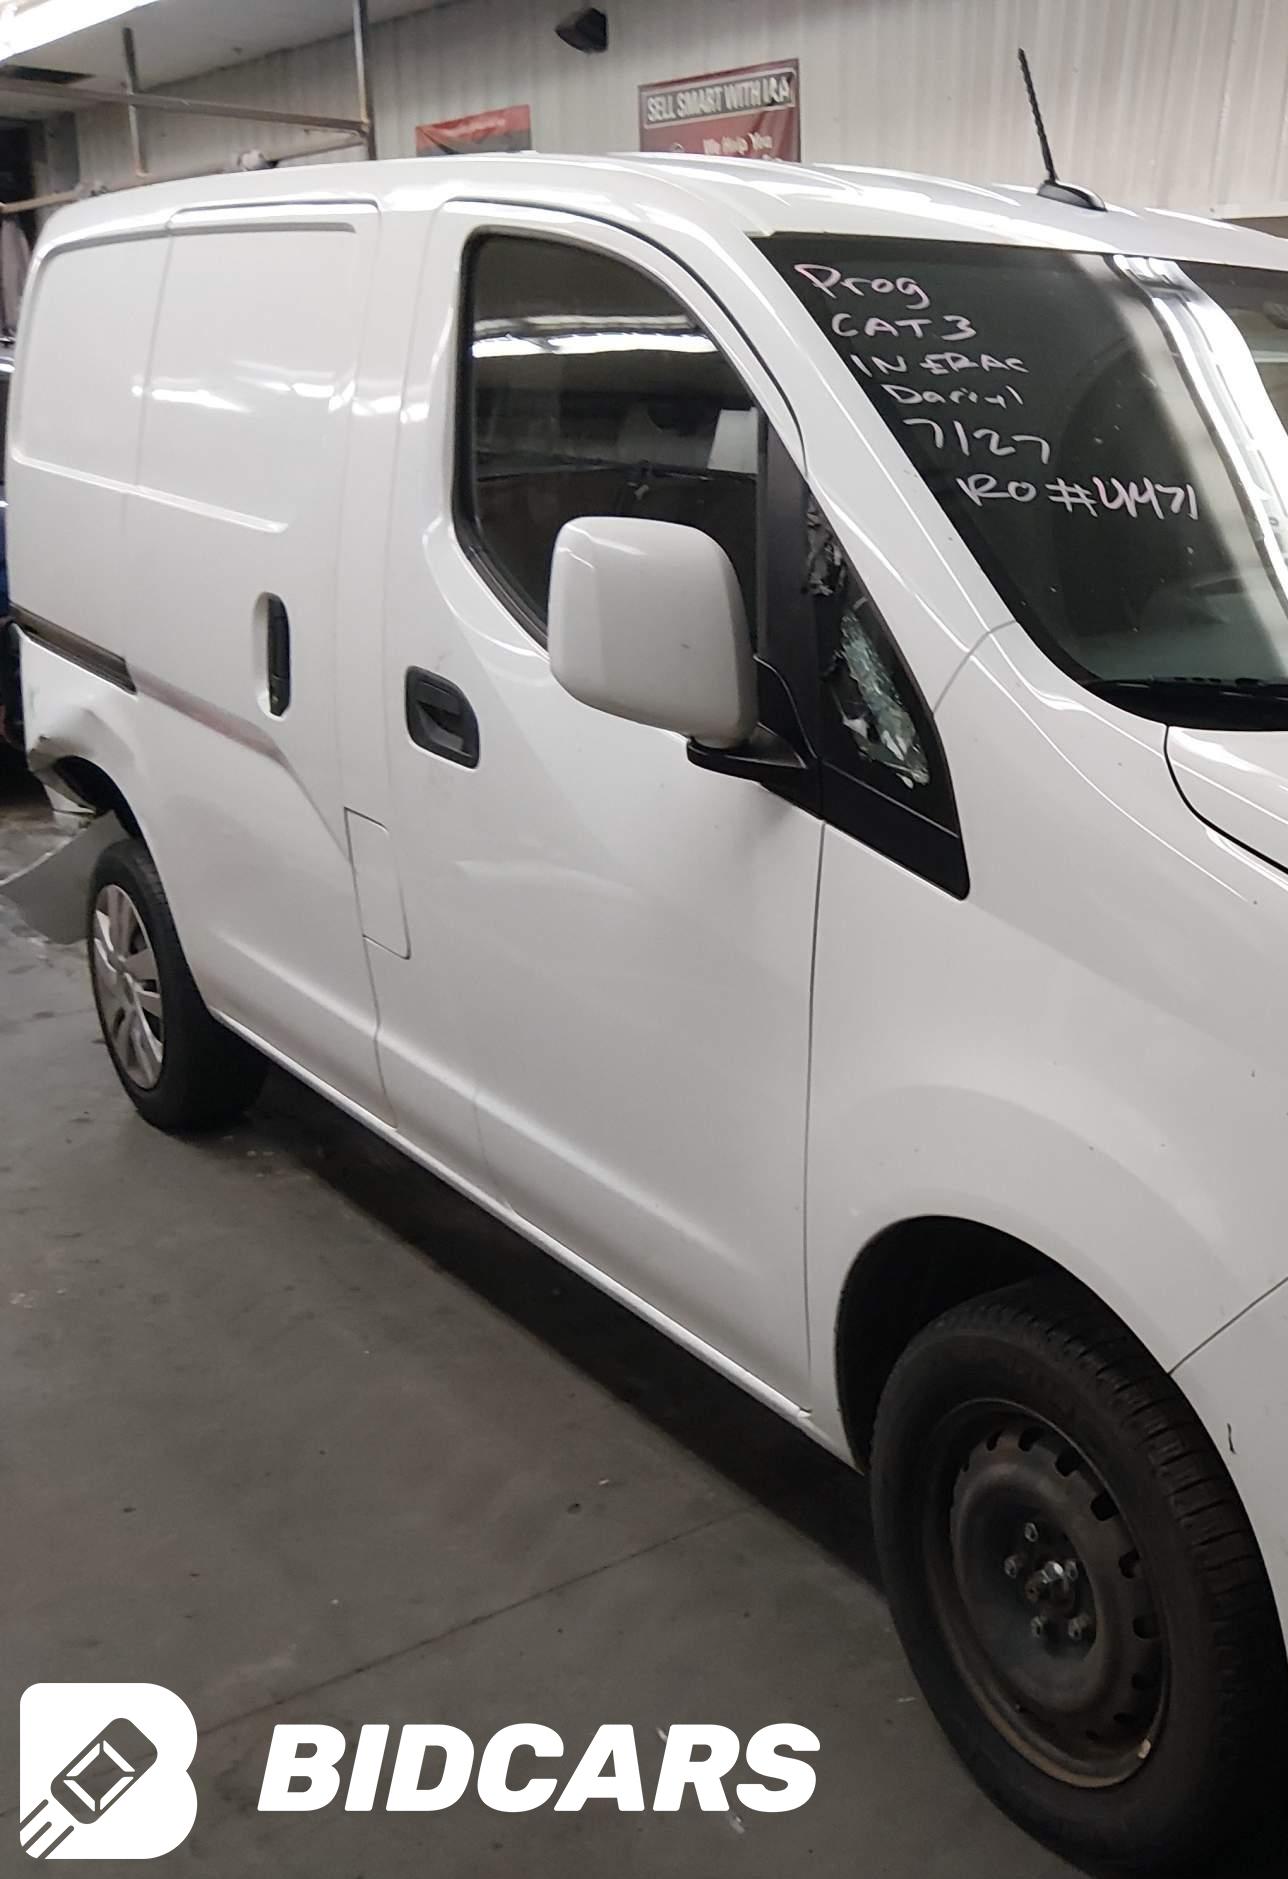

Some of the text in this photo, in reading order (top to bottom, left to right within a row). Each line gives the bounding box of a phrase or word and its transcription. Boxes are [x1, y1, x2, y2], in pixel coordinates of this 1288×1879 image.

[647, 95, 677, 121] SELL
[677, 86, 723, 118] SMART
[723, 79, 762, 110] WITH
[794, 263, 930, 310] Prog
[831, 313, 977, 341] CAT 3
[850, 354, 906, 377] IN
[956, 473, 1036, 507] RO
